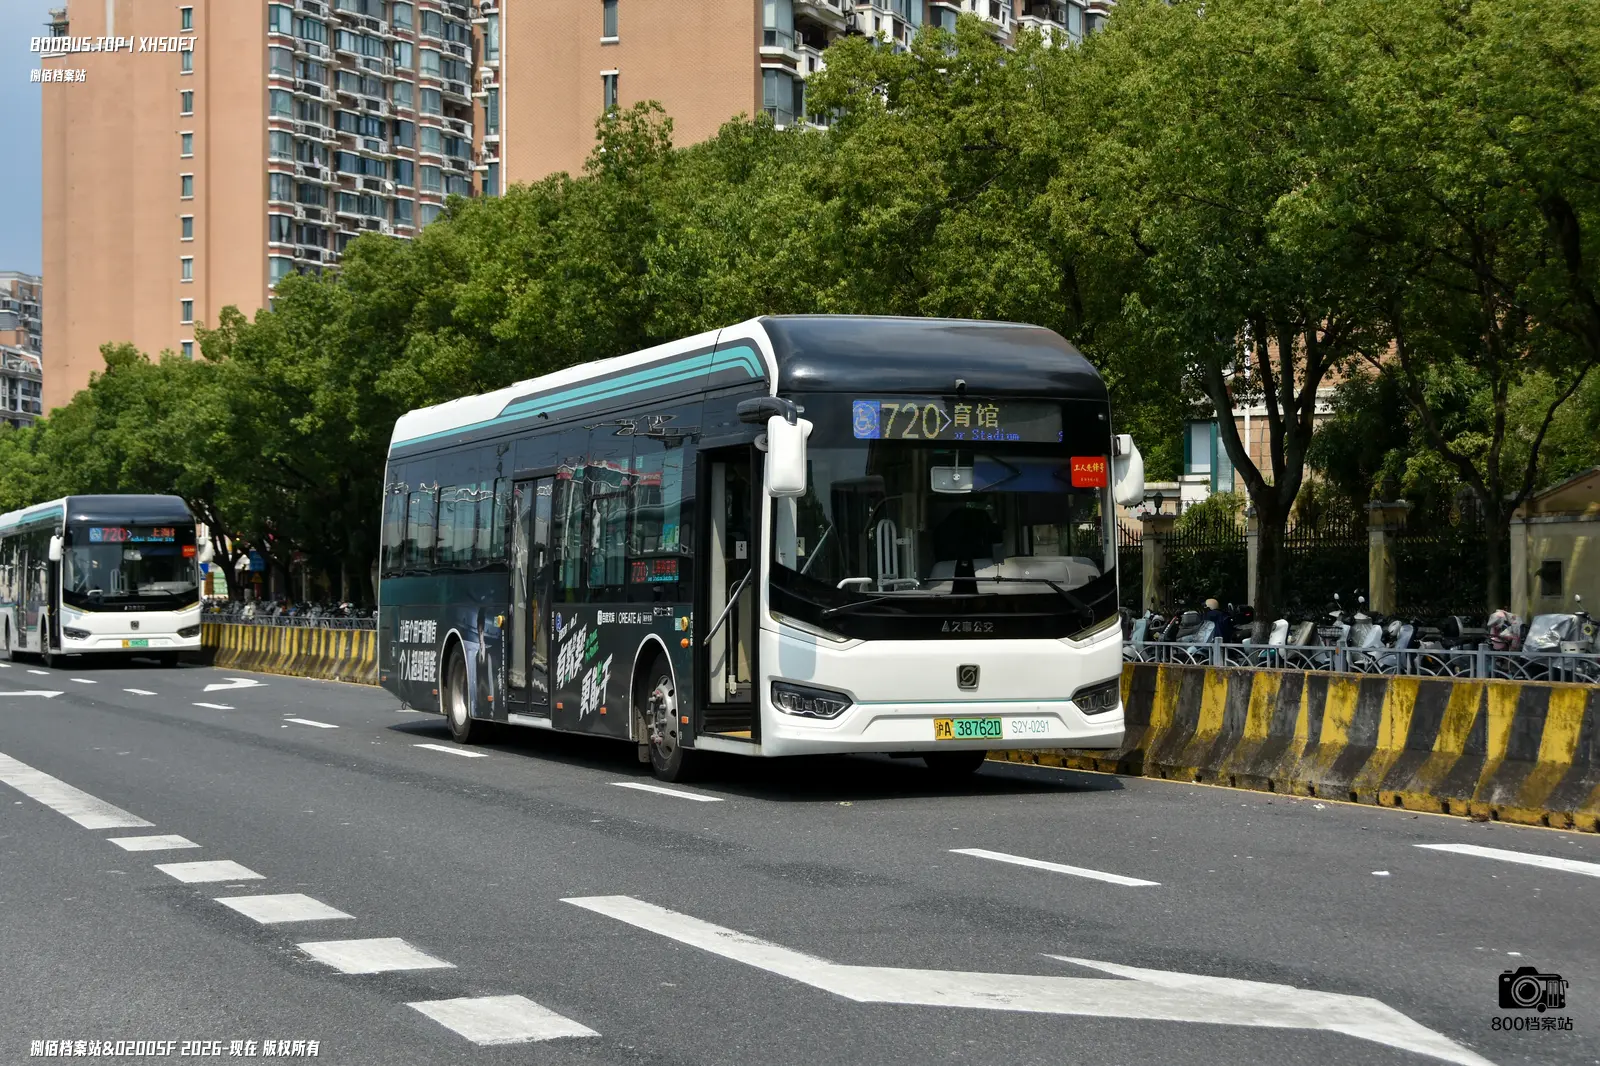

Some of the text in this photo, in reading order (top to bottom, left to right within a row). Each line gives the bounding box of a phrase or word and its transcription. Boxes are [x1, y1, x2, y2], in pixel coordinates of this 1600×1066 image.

[881, 402, 940, 439] 720
[954, 402, 999, 428] 育馆
[972, 428, 1020, 440] Stadium
[102, 527, 127, 542] 720
[957, 720, 1001, 736] 38762D
[1011, 720, 1050, 734] S2Y-0291
